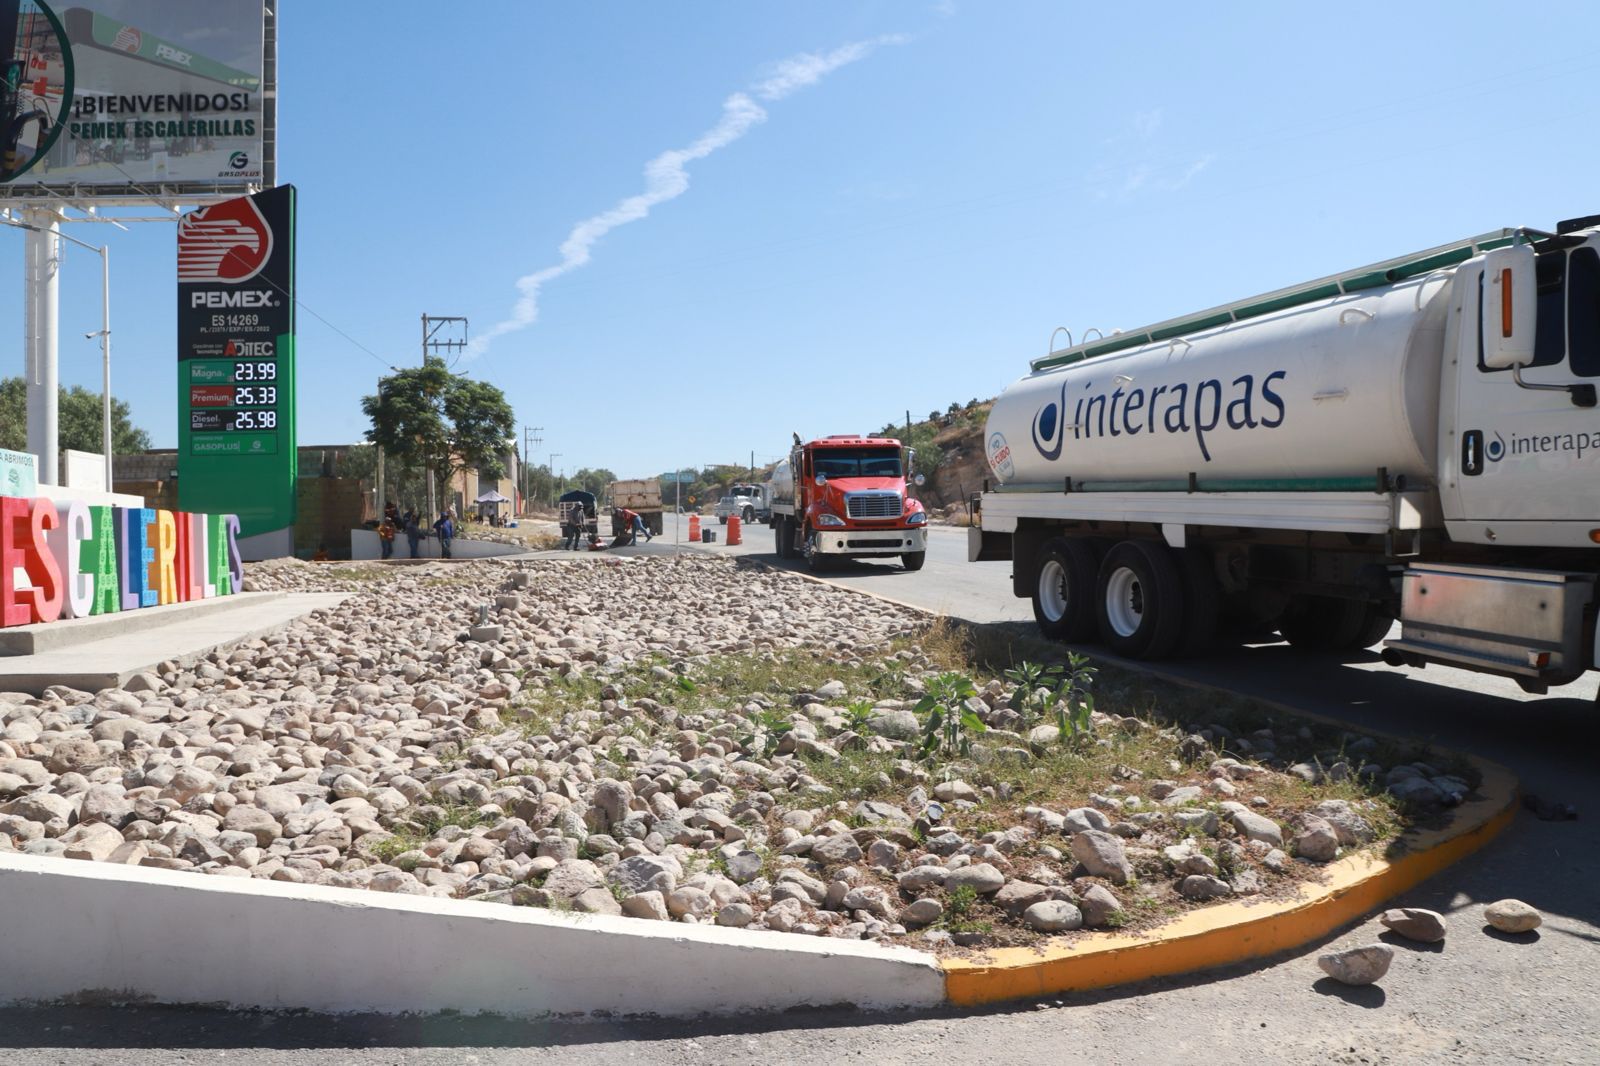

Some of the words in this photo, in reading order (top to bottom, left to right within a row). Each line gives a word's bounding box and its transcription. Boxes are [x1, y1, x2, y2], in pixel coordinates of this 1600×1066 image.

[156, 44, 192, 66] PEMEX
[74, 93, 249, 118] ¡BIENVENIDOS!
[70, 121, 127, 140] PEMEX
[134, 119, 256, 138] ESCALERILLAS
[191, 290, 273, 309] PEMEX
[212, 314, 225, 327] ES
[226, 314, 259, 326] 14269
[192, 370, 223, 380] Magna
[235, 363, 276, 380] 23.99
[192, 393, 230, 402] Premium
[235, 387, 276, 404] 25.33
[192, 414, 219, 423] Diesel
[235, 411, 276, 428] 25.98
[1074, 370, 1287, 462] interapas
[1, 496, 243, 627] ESCALERILLAS
